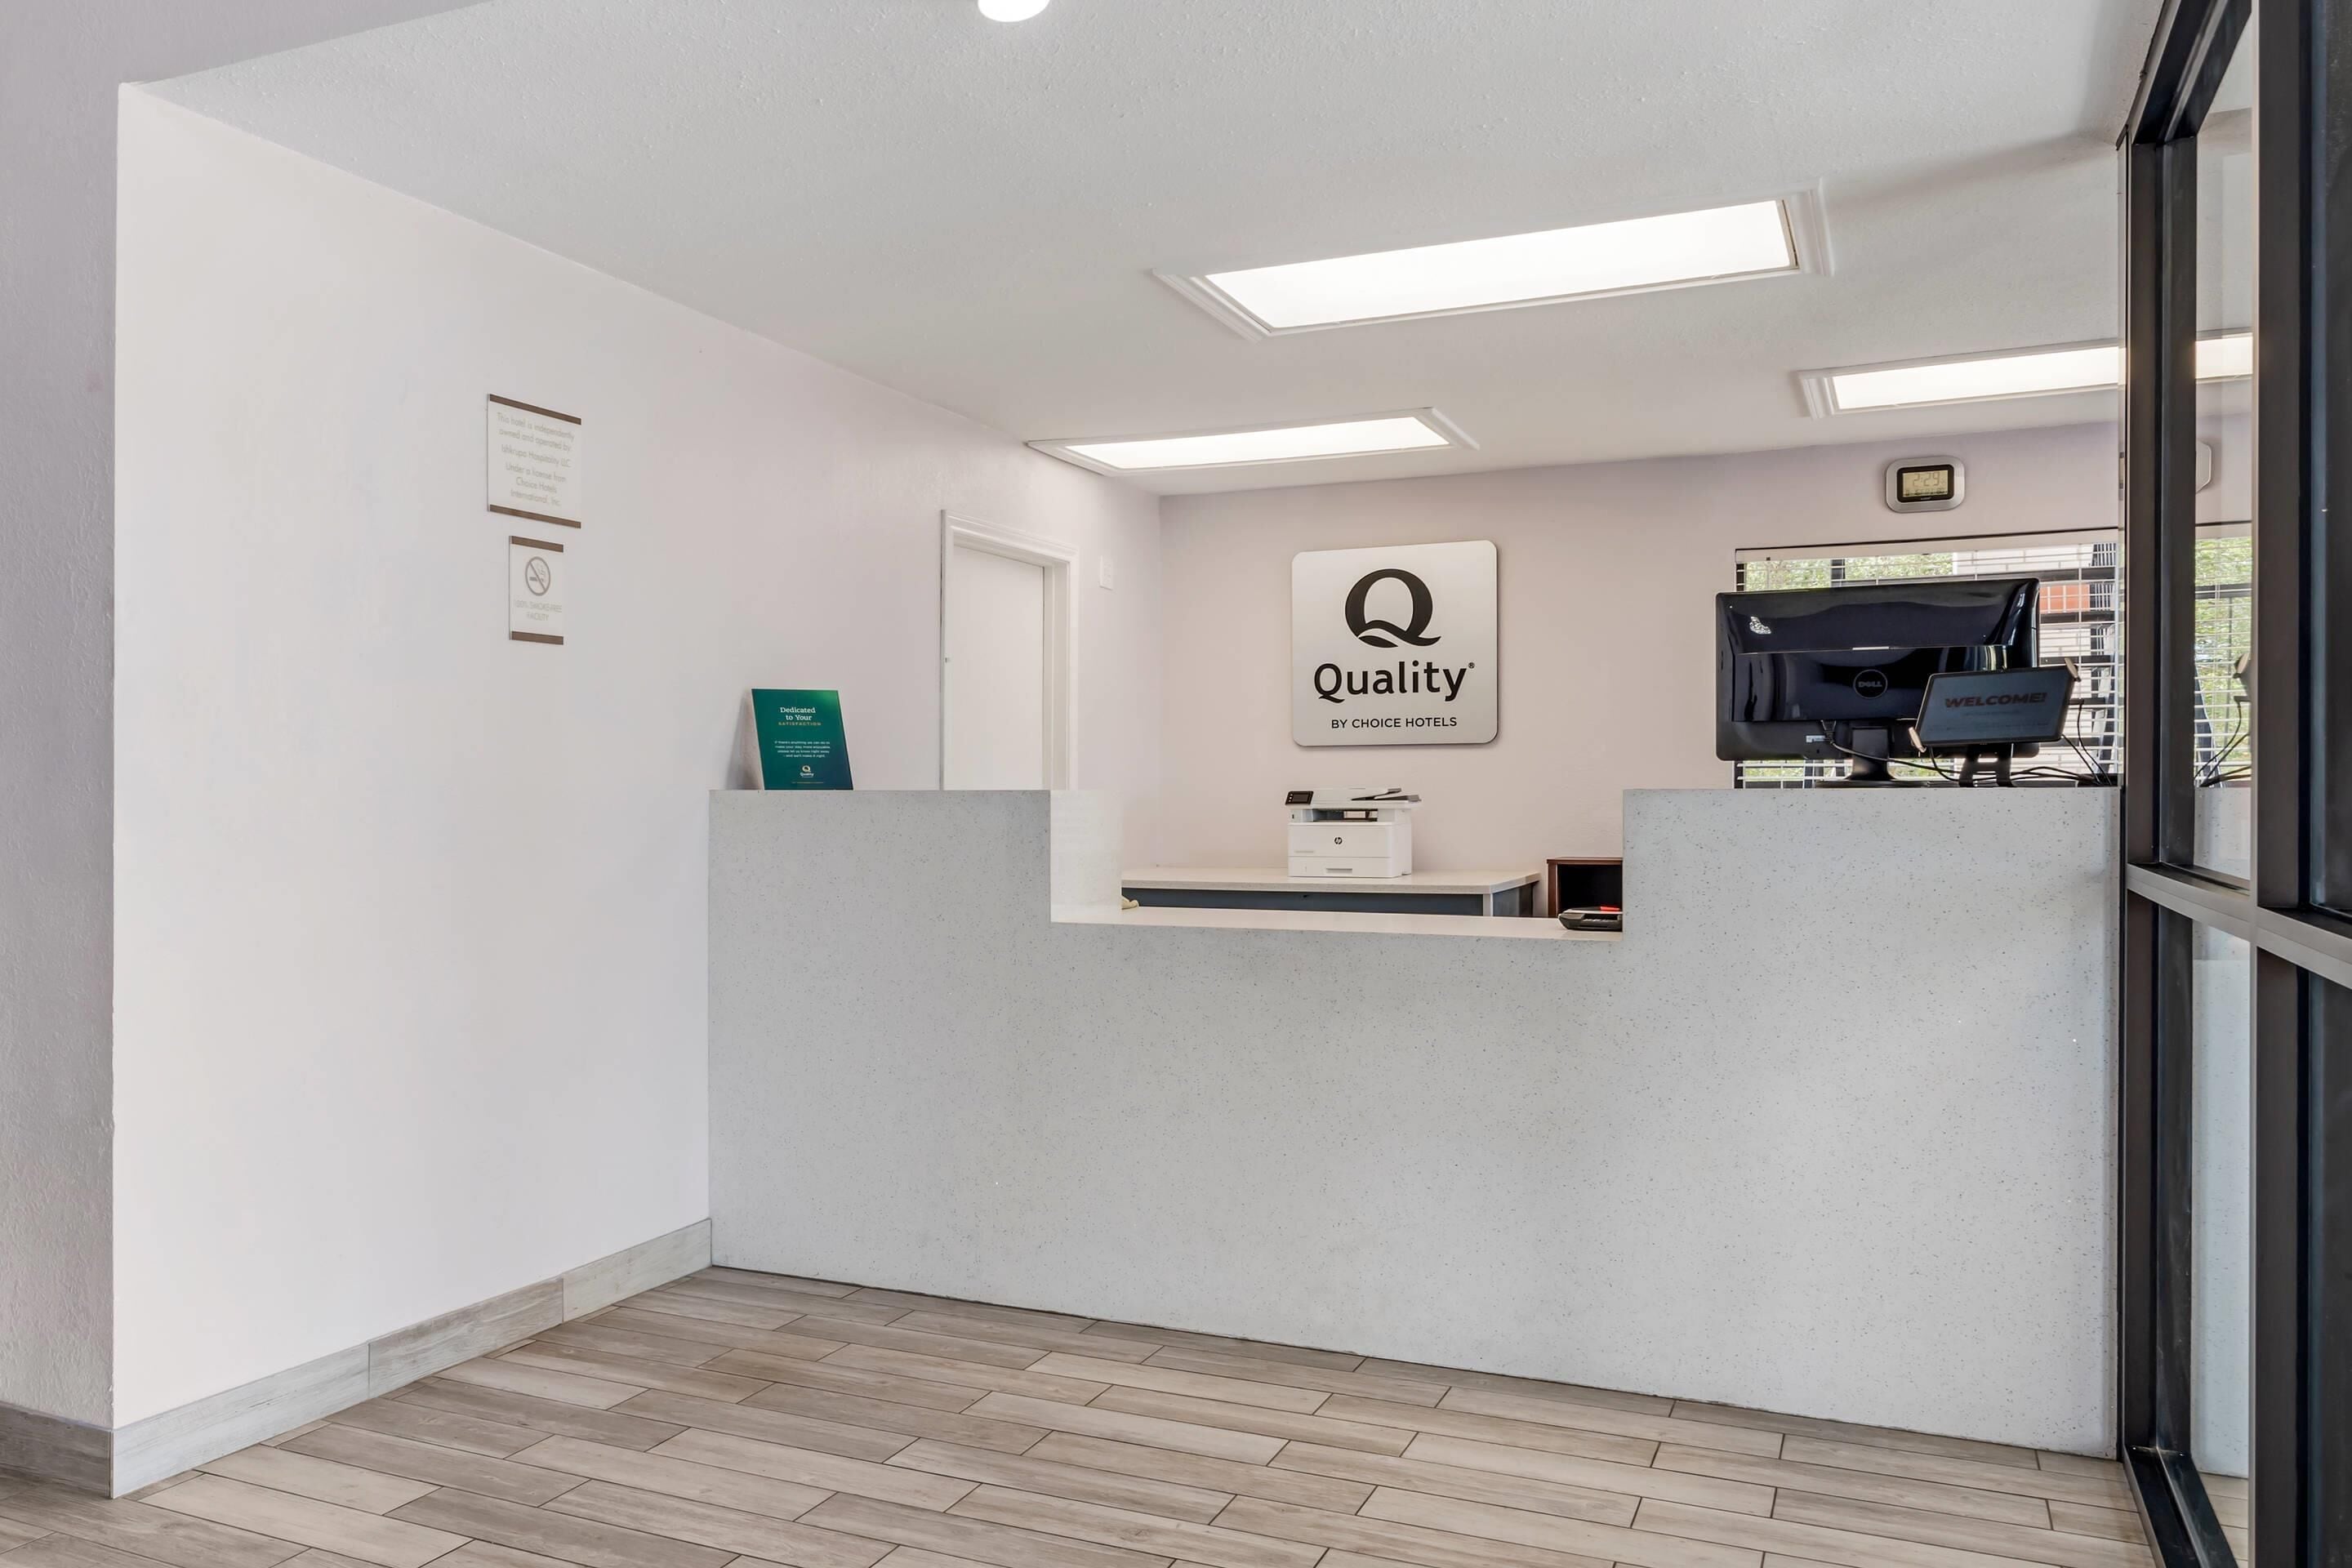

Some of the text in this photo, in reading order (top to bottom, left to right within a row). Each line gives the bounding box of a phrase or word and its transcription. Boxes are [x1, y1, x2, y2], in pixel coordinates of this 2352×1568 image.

[497, 412, 574, 443] This hotel is independently
[499, 429, 571, 455] owned and operated by
[529, 451, 559, 468] Hospitality
[561, 457, 572, 468] LLC
[506, 461, 525, 473] Under
[532, 466, 552, 479] license
[553, 471, 567, 482] from
[1913, 472, 1940, 487] 2:29
[515, 476, 557, 493] Choice Hotels
[1945, 693, 2047, 708] WELCOME!
[1331, 716, 1458, 729] BY CHOICE HOTELS
